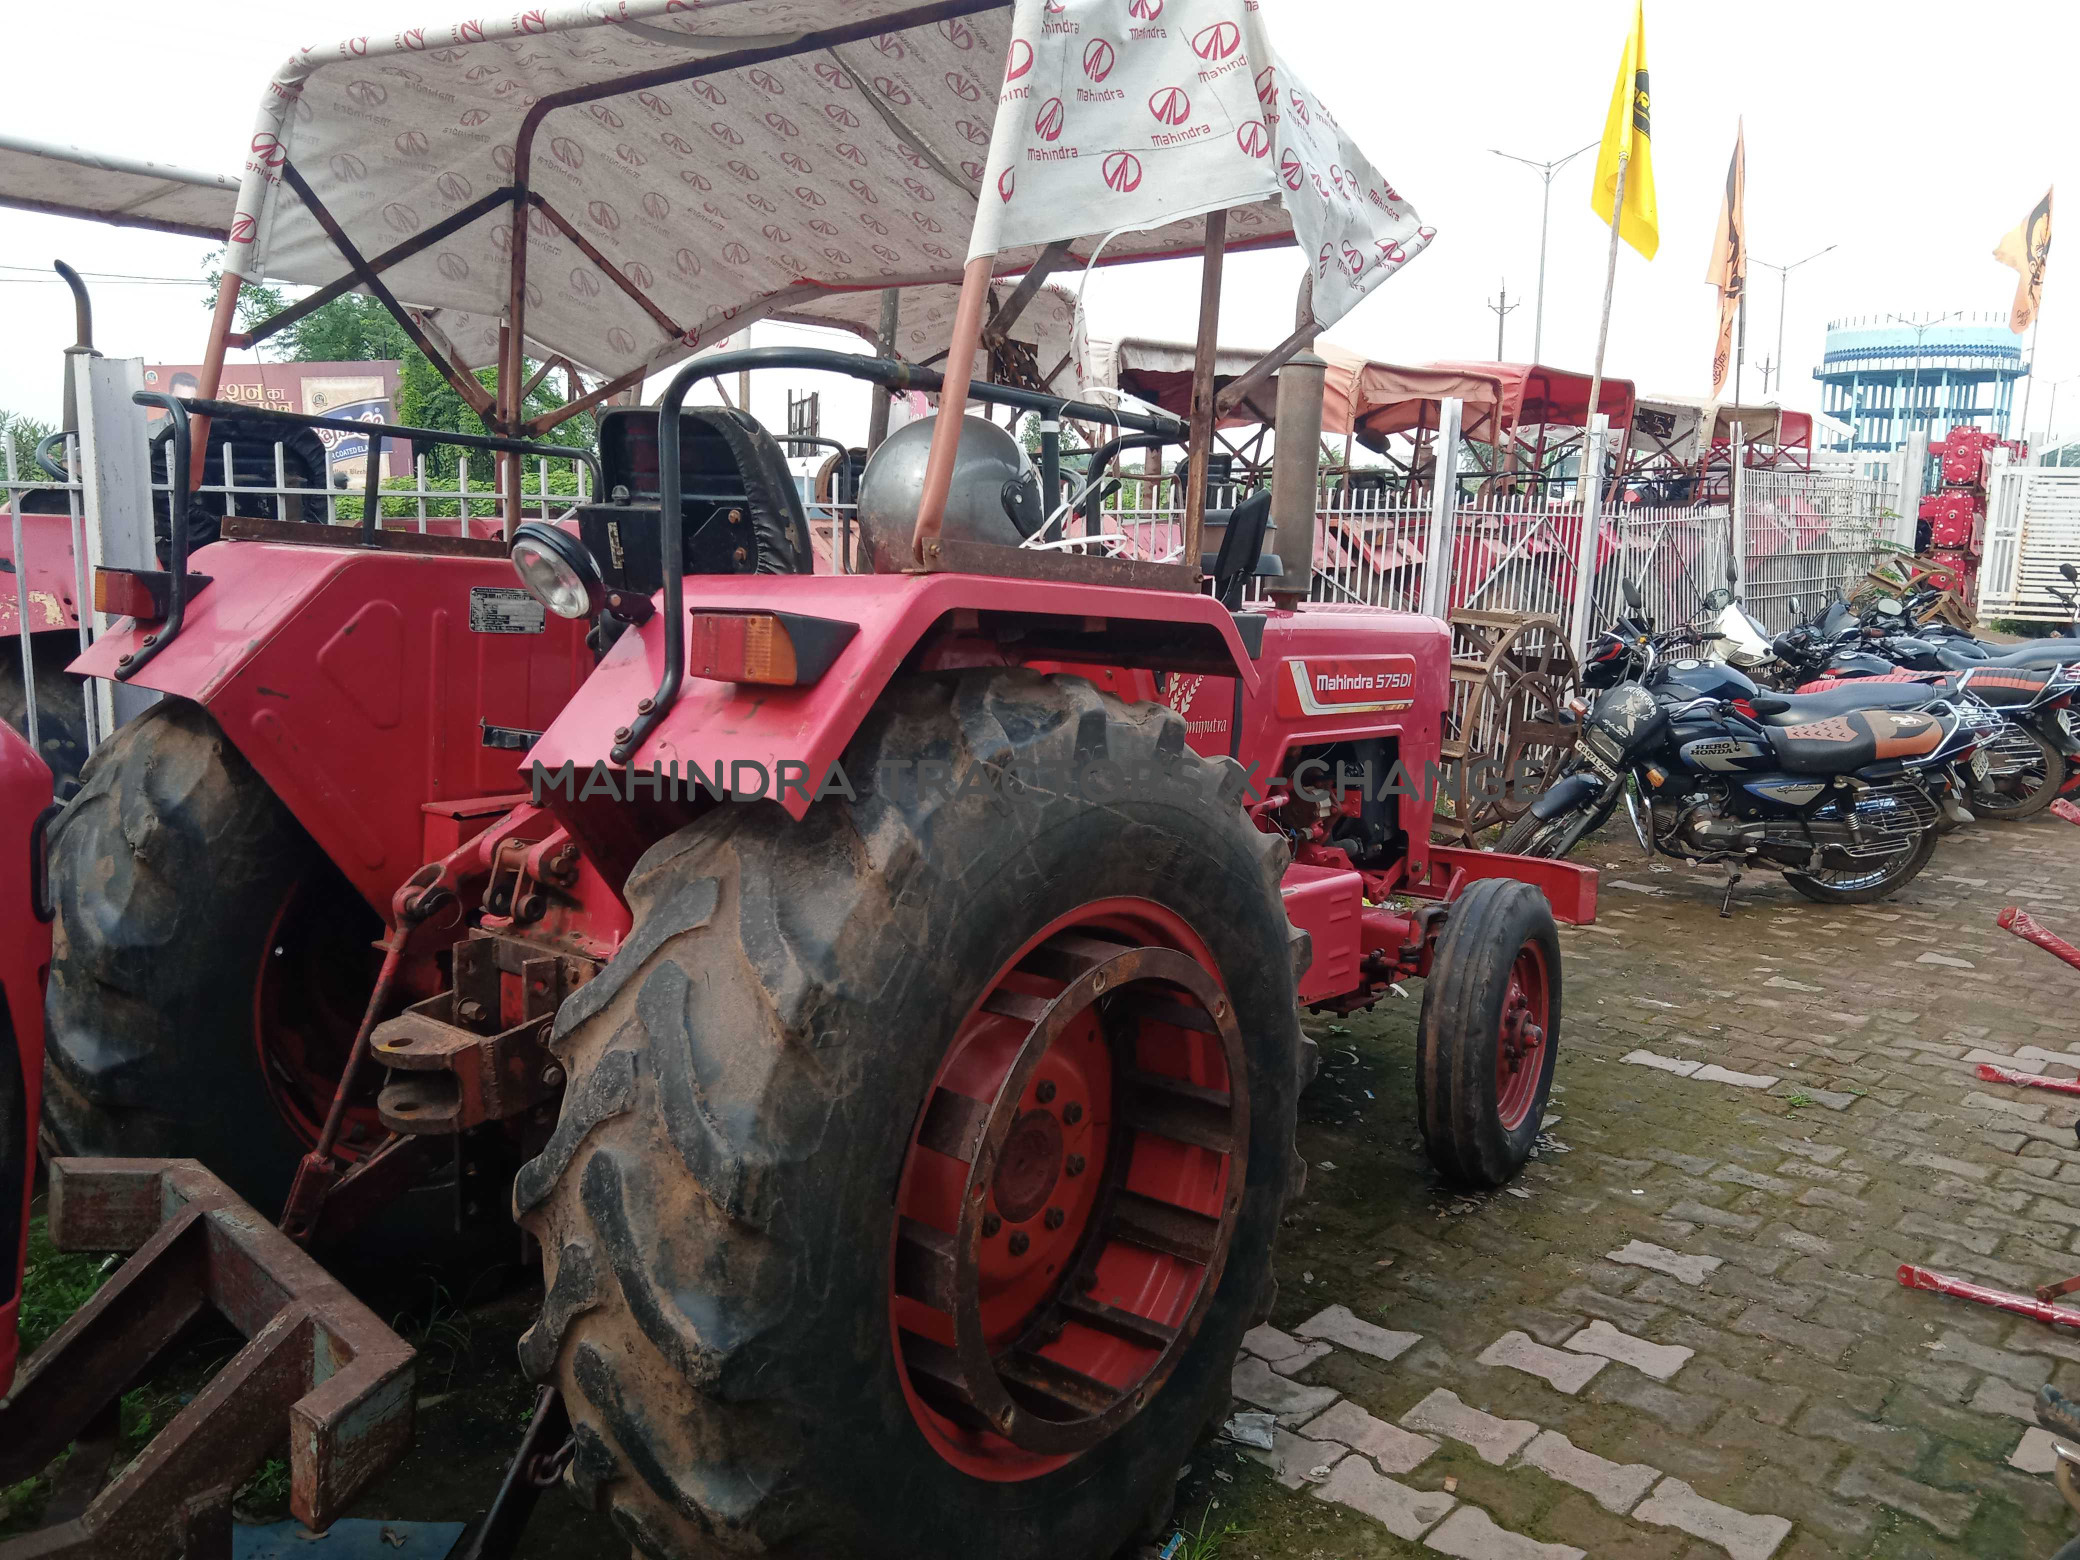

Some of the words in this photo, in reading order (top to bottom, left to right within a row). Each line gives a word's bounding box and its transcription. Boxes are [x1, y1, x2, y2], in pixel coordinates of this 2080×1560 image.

[1076, 87, 1125, 103] Mahindra
[1151, 123, 1211, 148] Mahindra
[1027, 147, 1079, 162] Mahindra
[1368, 188, 1400, 222] Mahindra
[266, 388, 285, 401] का
[336, 446, 358, 459] COATED
[1316, 673, 1373, 691] Mahindra
[1376, 673, 1412, 688] 575DI
